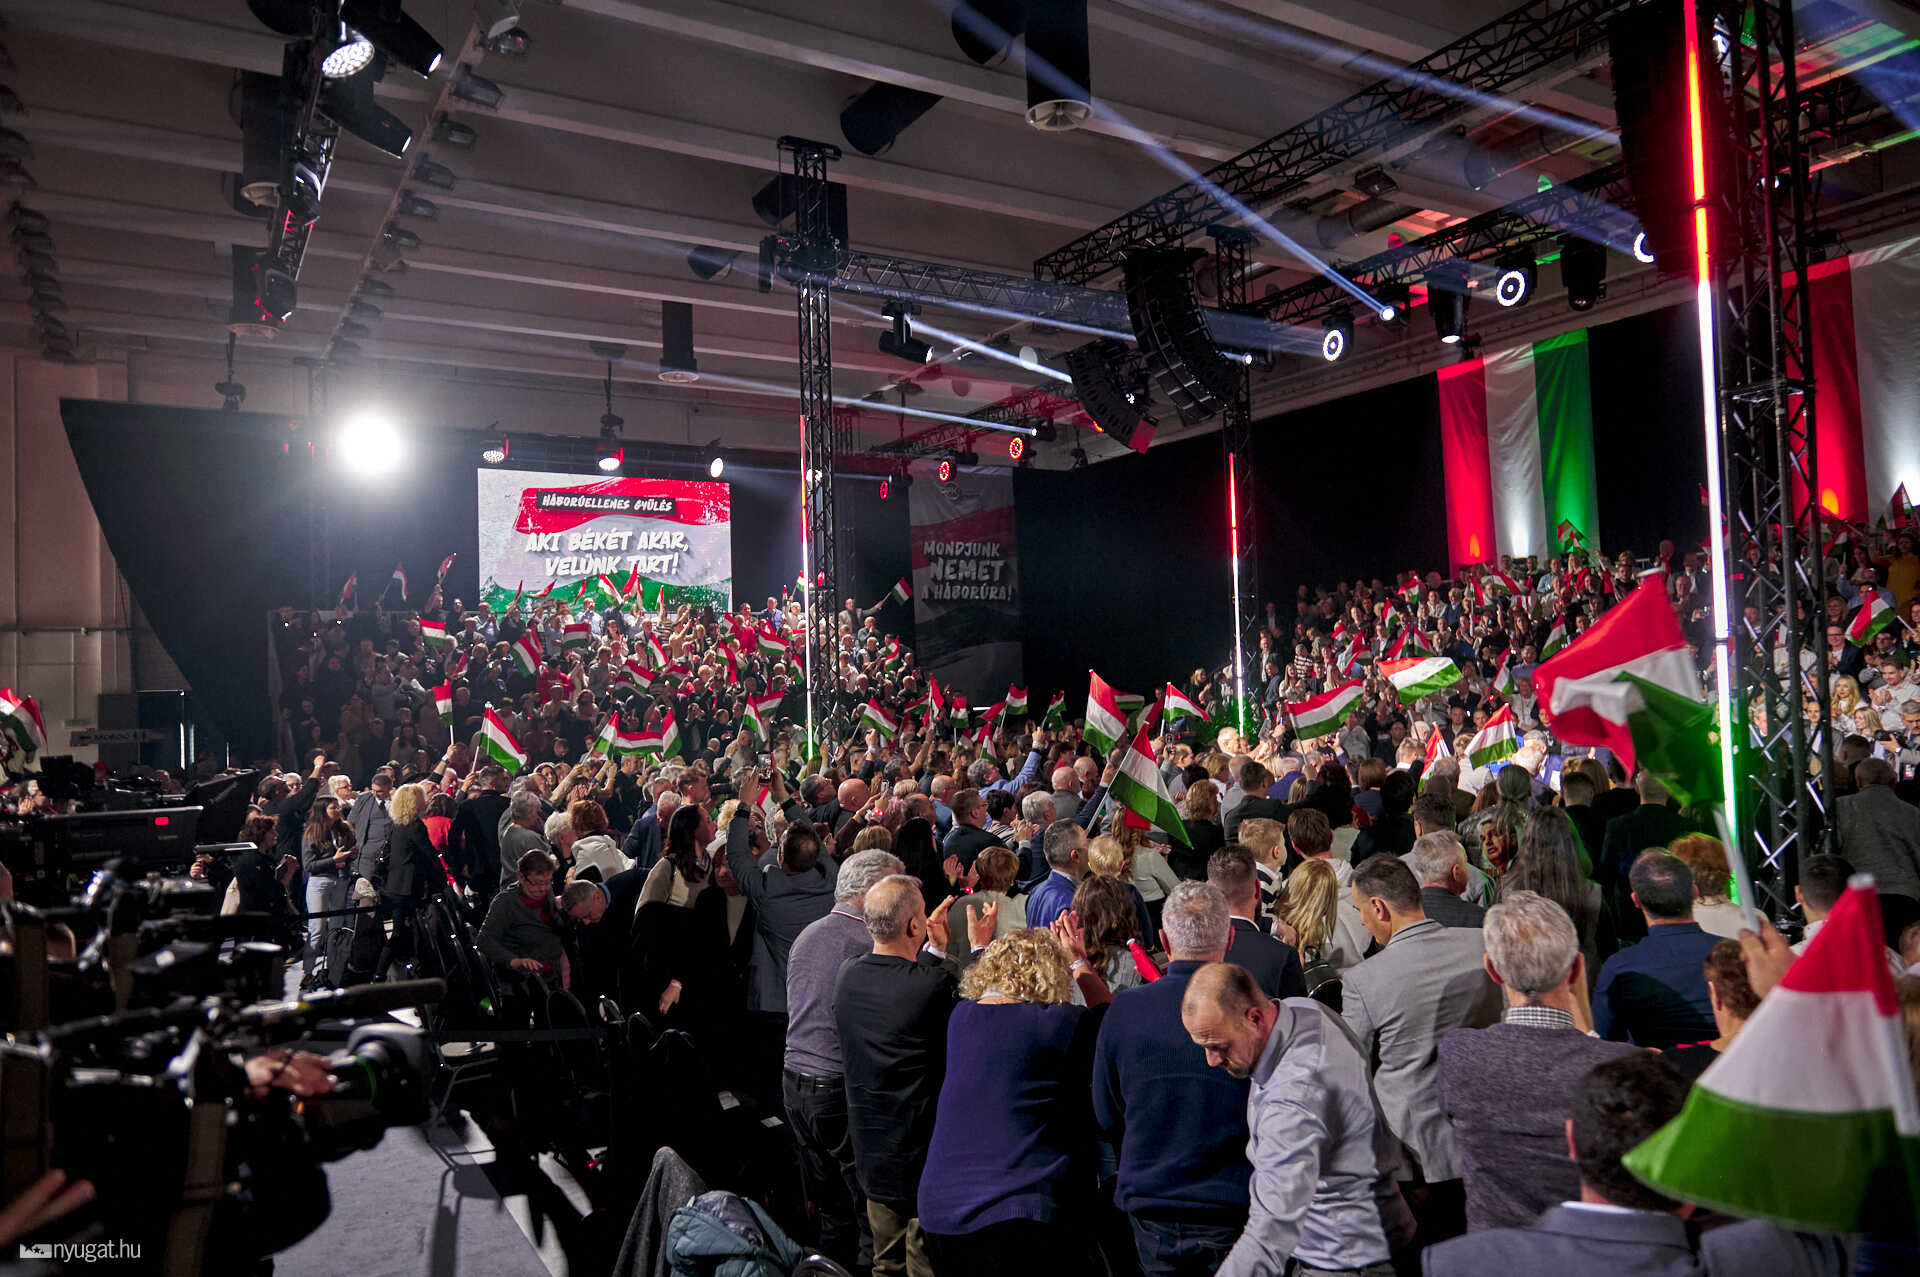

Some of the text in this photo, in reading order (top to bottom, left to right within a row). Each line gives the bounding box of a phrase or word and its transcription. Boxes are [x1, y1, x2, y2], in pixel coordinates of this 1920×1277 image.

[542, 495, 630, 510] HÁBORÚELLENES
[526, 529, 689, 552] AKI BÉKÉT AKAR,
[923, 541, 1000, 556] MONDJUNK
[545, 552, 680, 576] VELÜNK TART!
[929, 558, 1005, 581] NEMET
[921, 583, 1012, 600] A HÁBORÚRA!
